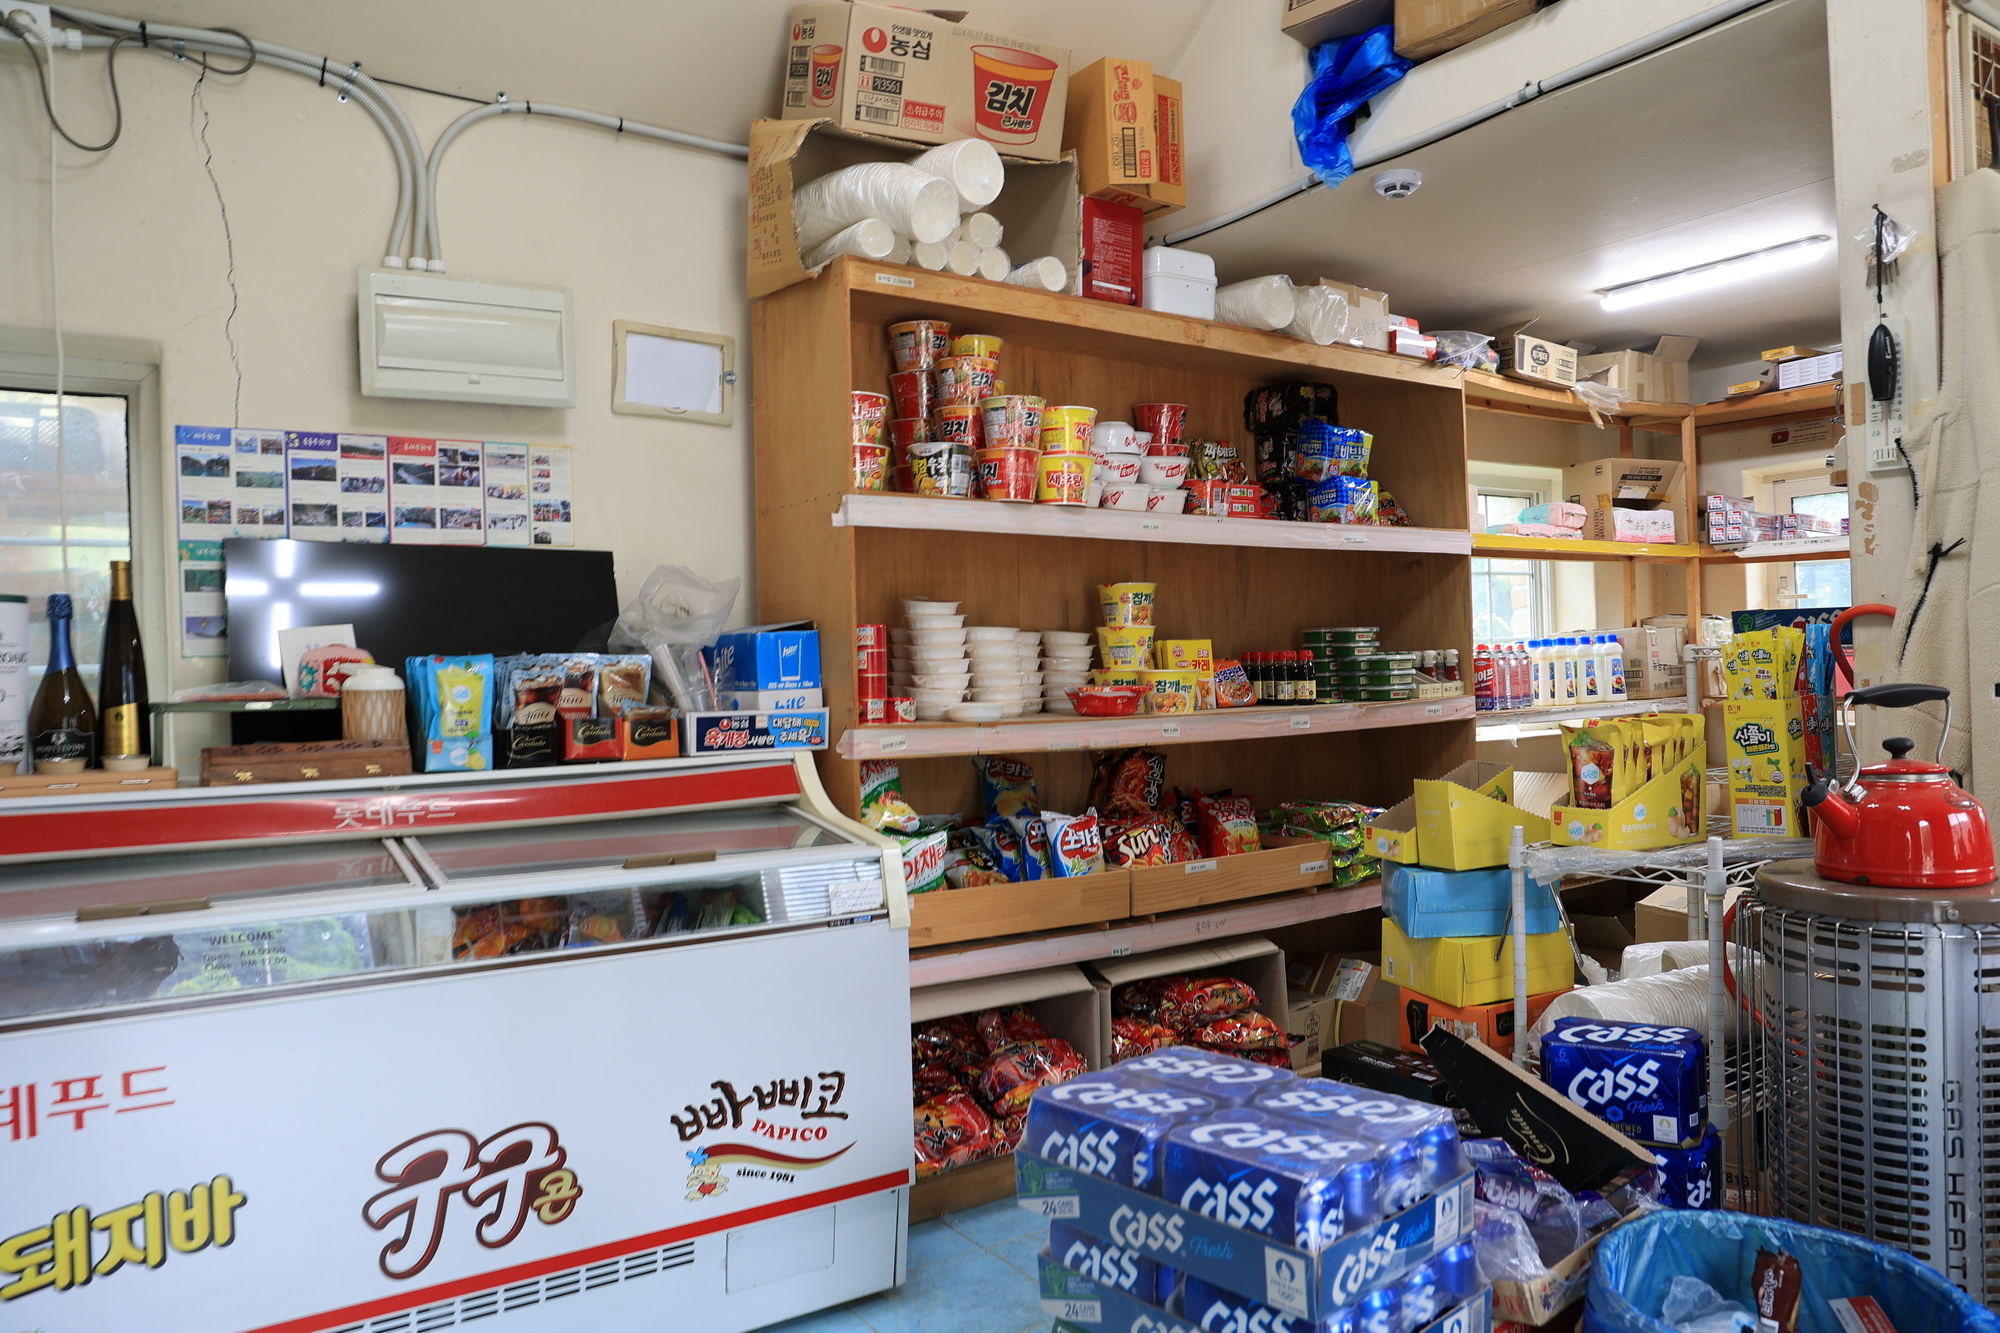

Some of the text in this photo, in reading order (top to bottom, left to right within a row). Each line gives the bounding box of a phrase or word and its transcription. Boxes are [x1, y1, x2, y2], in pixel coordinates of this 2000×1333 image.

[890, 35, 932, 61] 농심
[816, 66, 835, 88] 김치
[985, 80, 1036, 117] 김치
[914, 106, 943, 118] 취급주의
[1141, 151, 1151, 177] 용기면
[971, 371, 994, 387] 김치
[943, 419, 969, 436] 김치
[1340, 445, 1370, 461] 비빔면
[1048, 471, 1085, 489] 새우탕
[713, 645, 735, 672] hite
[782, 644, 798, 657] hite
[1197, 648, 1210, 658] 3분
[578, 721, 612, 740] Cantata
[635, 723, 669, 741] Cantata
[772, 716, 802, 730] 대답해
[512, 733, 547, 750] Cantata
[704, 727, 775, 749] 육개장 사발면
[1735, 724, 1772, 746] 신쫄이
[989, 760, 1034, 778] 포카칩
[333, 796, 457, 829] 롯데푸드
[1062, 826, 1101, 852] 포카칩
[1117, 828, 1160, 868] Sun
[670, 1070, 849, 1142] 빠삐코
[1627, 1099, 1665, 1114] Fresh
[1942, 1080, 1964, 1160] GAS
[751, 1118, 828, 1142] PAPICO
[736, 1166, 796, 1184] since 1981
[1042, 1200, 1057, 1217] 24
[0, 1173, 248, 1300] 돼지바
[1189, 1235, 1234, 1261] Fresh
[1065, 1303, 1079, 1318] 24
